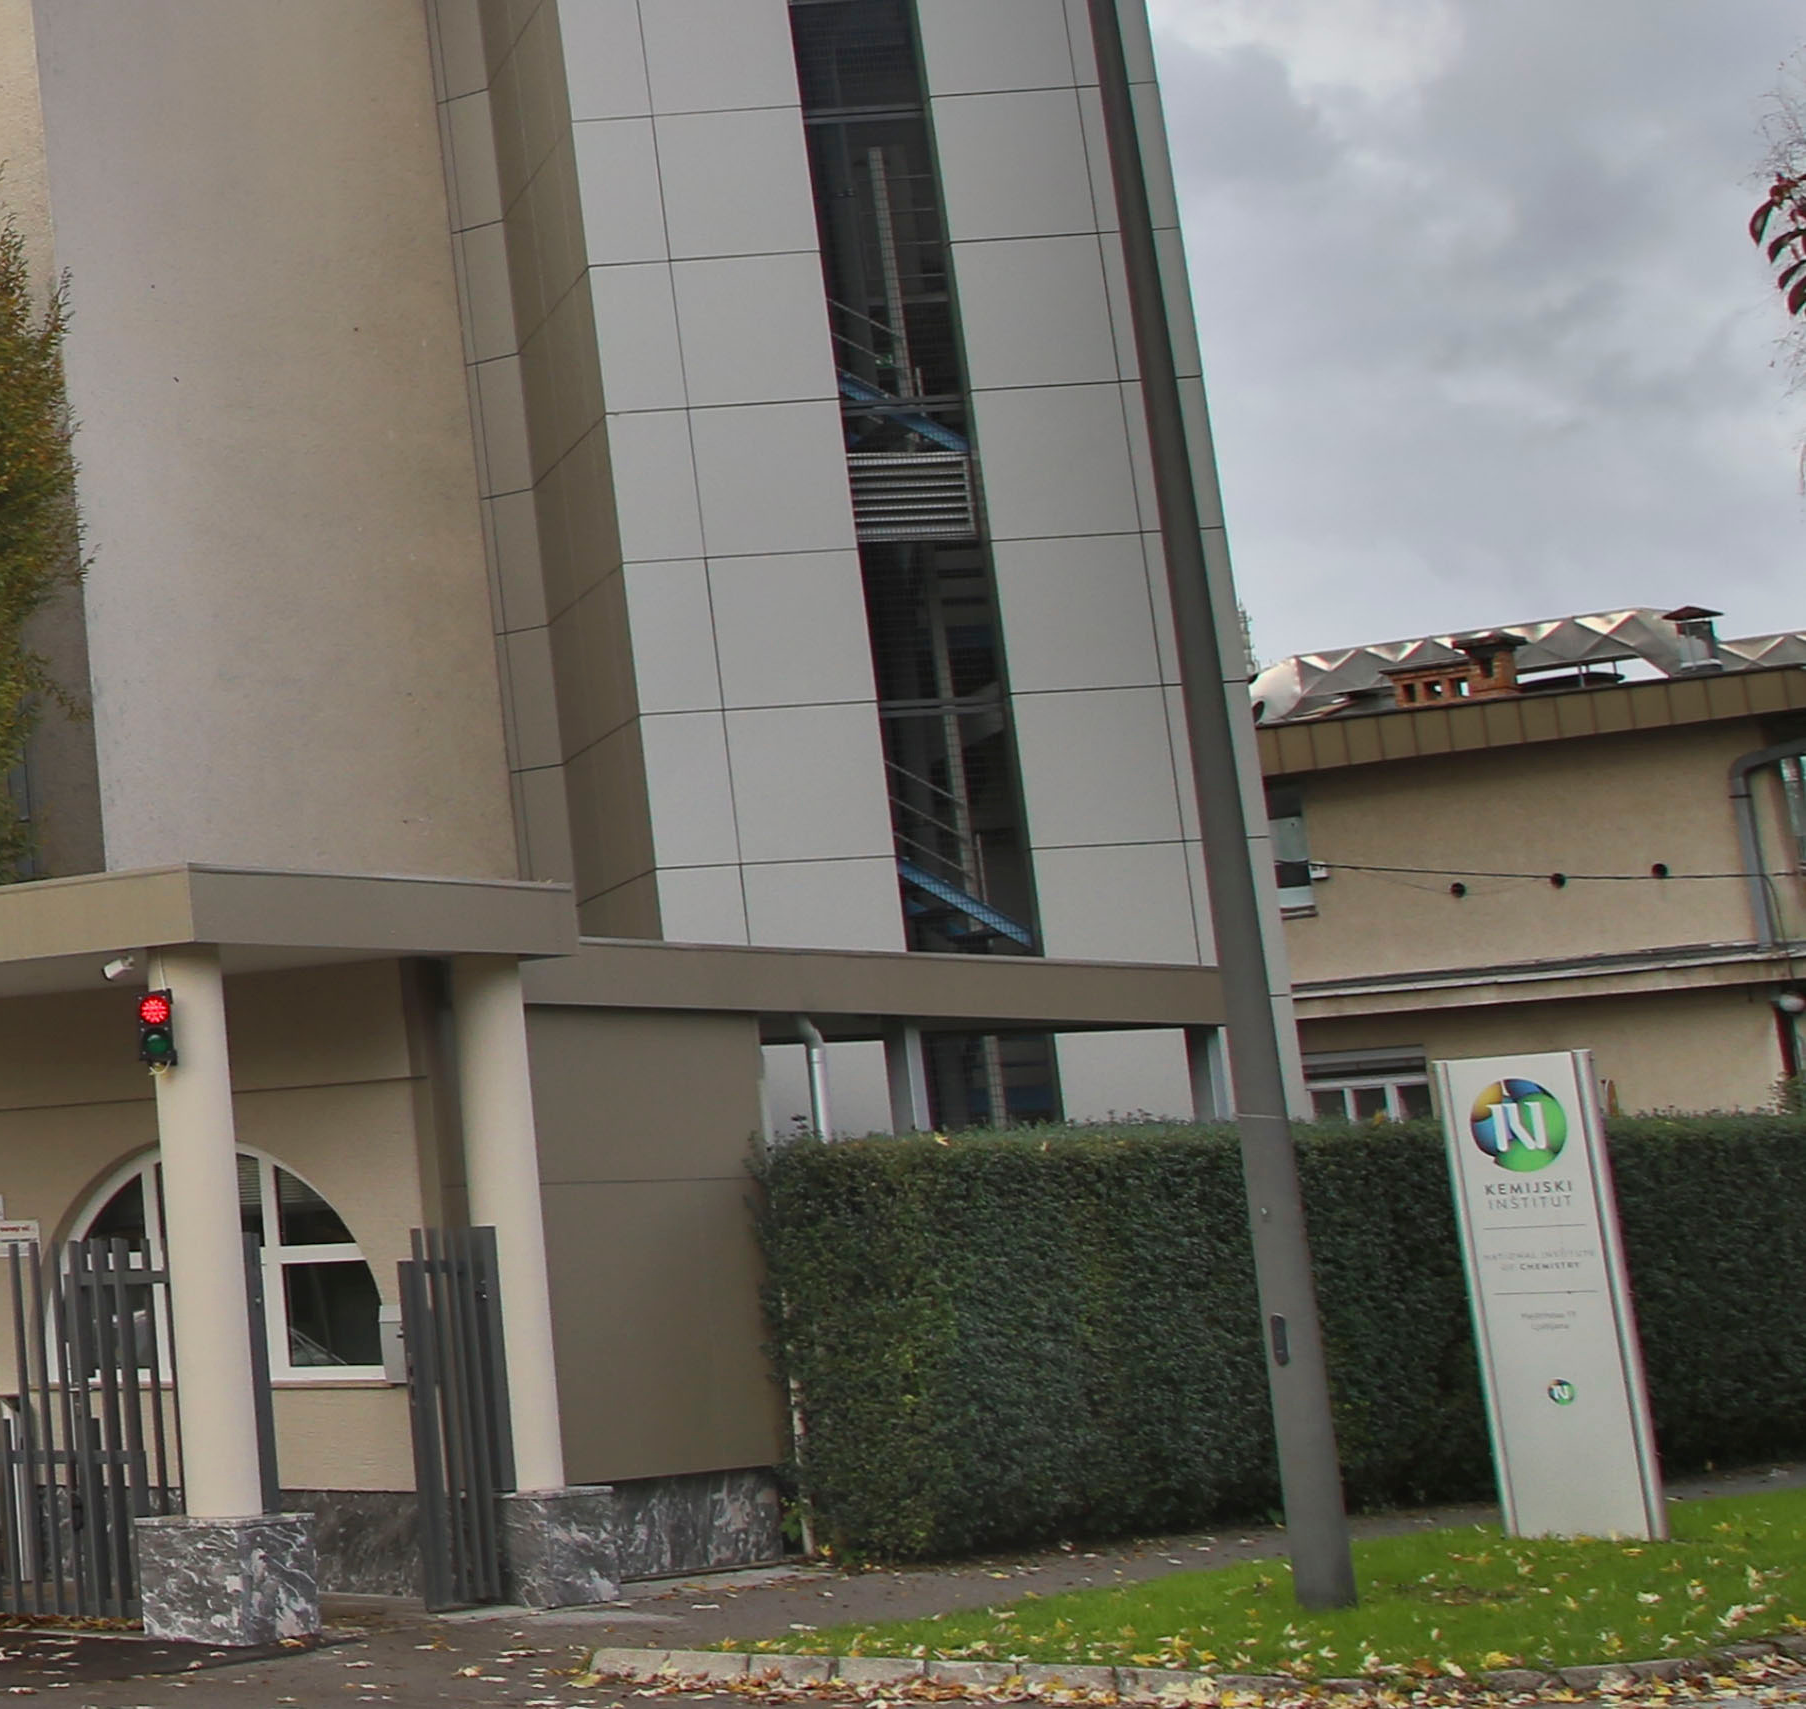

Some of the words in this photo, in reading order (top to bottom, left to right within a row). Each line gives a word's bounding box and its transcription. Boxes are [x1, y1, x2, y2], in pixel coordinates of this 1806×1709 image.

[1484, 1179, 1573, 1196] KEMIJSKI
[1487, 1194, 1572, 1210] INŠTITUT
[1519, 1262, 1580, 1271] CHEMISTRY
